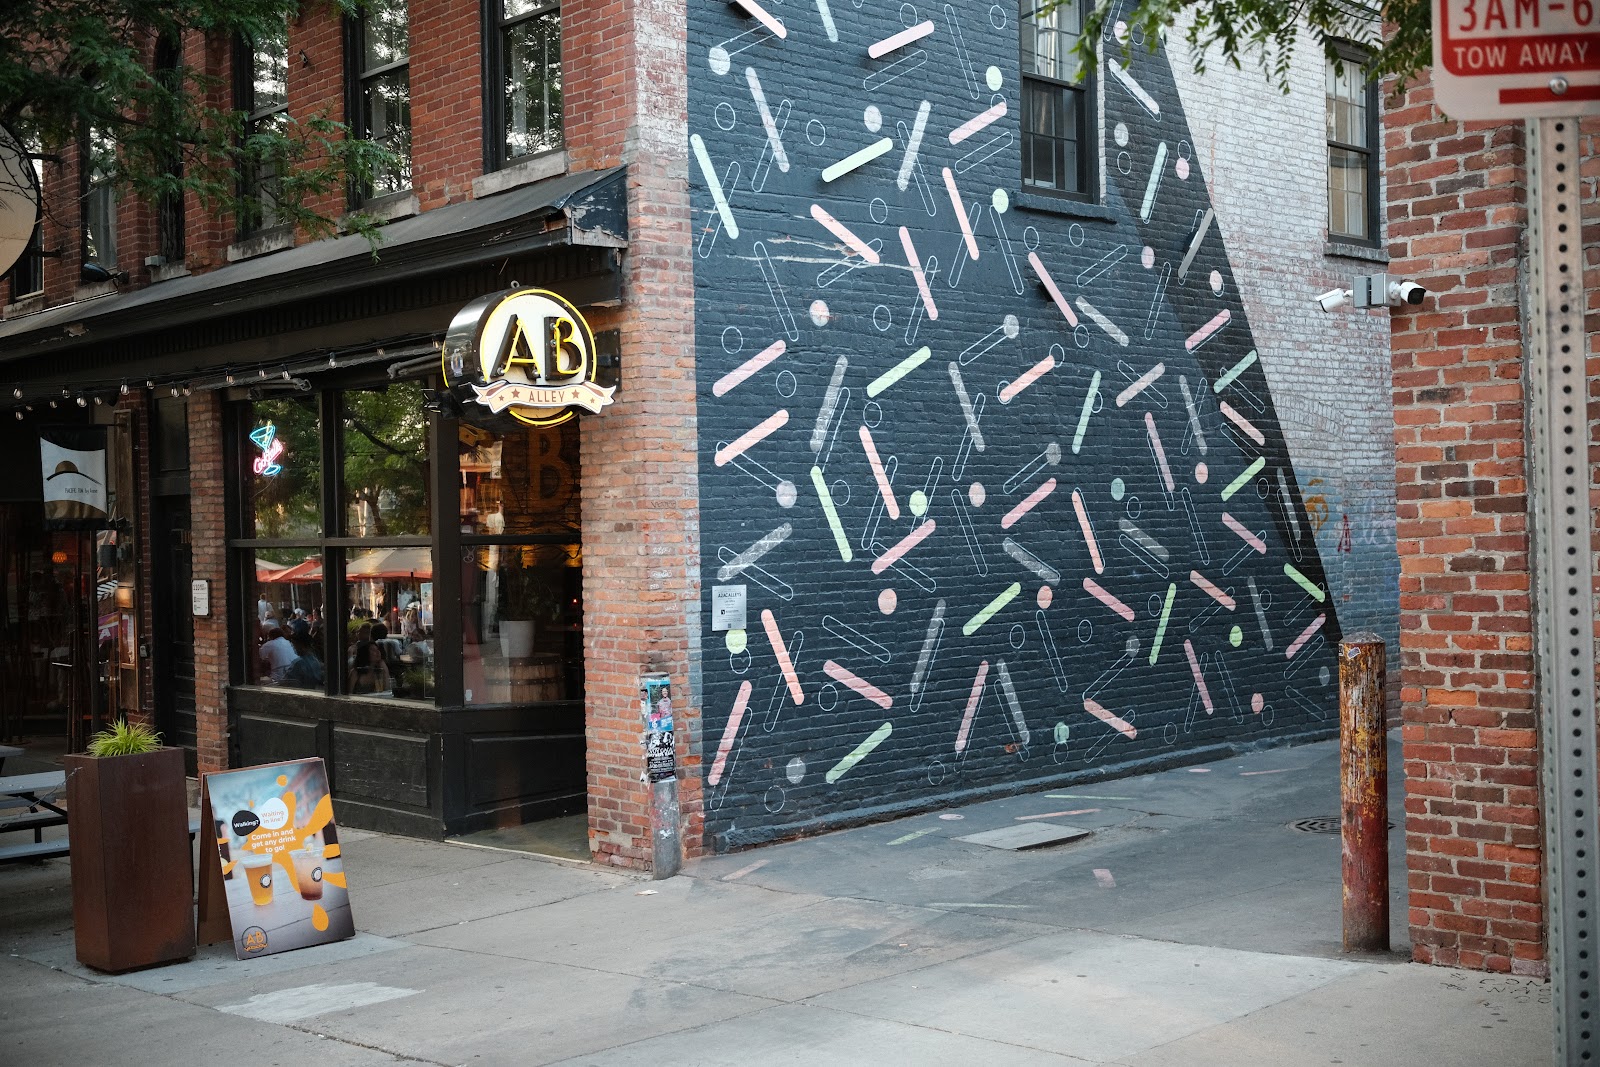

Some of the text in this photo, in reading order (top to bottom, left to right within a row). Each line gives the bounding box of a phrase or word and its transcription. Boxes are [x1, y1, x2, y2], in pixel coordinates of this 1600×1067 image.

[1459, 0, 1600, 32] 3AM-6
[1453, 41, 1589, 69] TOW AWAY
[490, 313, 584, 382] AB
[528, 390, 565, 403] ALLEY
[261, 810, 284, 818] Waiting
[233, 819, 259, 829] Walking?
[251, 833, 271, 841] Come
[280, 828, 294, 836] and
[251, 835, 297, 849] get any drink
[273, 844, 285, 853] go!
[246, 931, 264, 945] AB
